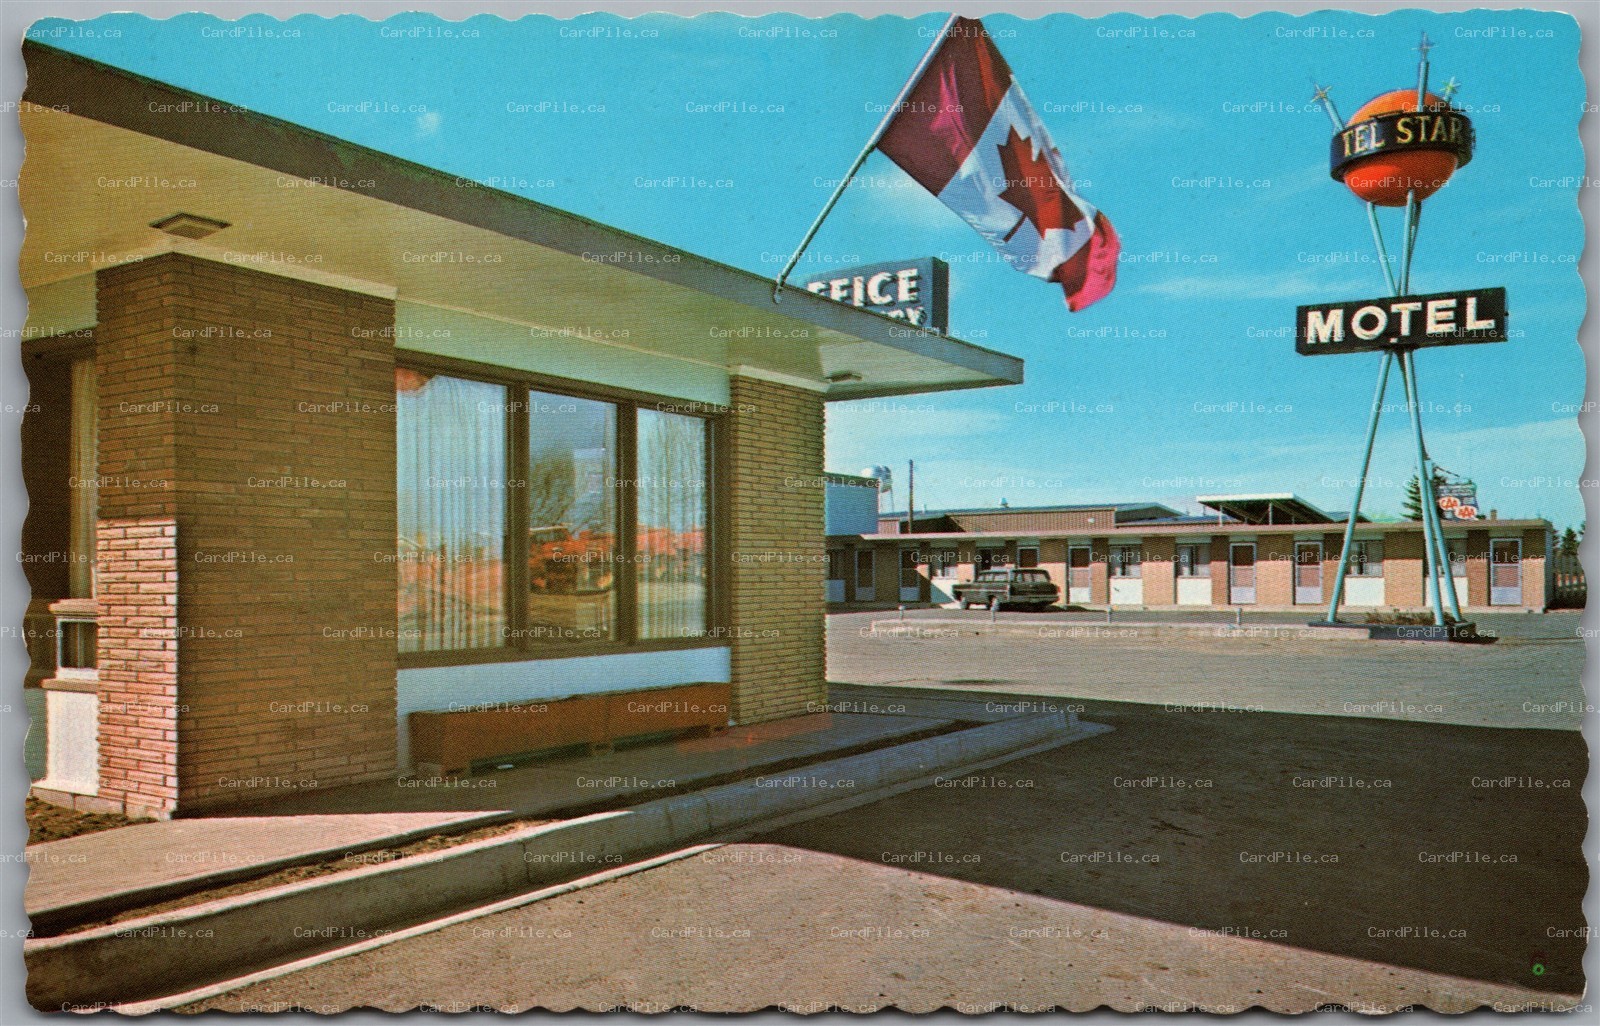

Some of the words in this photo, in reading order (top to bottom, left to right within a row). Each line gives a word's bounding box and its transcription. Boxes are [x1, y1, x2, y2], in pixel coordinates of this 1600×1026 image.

[1342, 121, 1386, 157] TEL
[1396, 115, 1464, 144] STAR
[807, 268, 919, 307] FFICE
[1306, 297, 1496, 344] MOTEL
